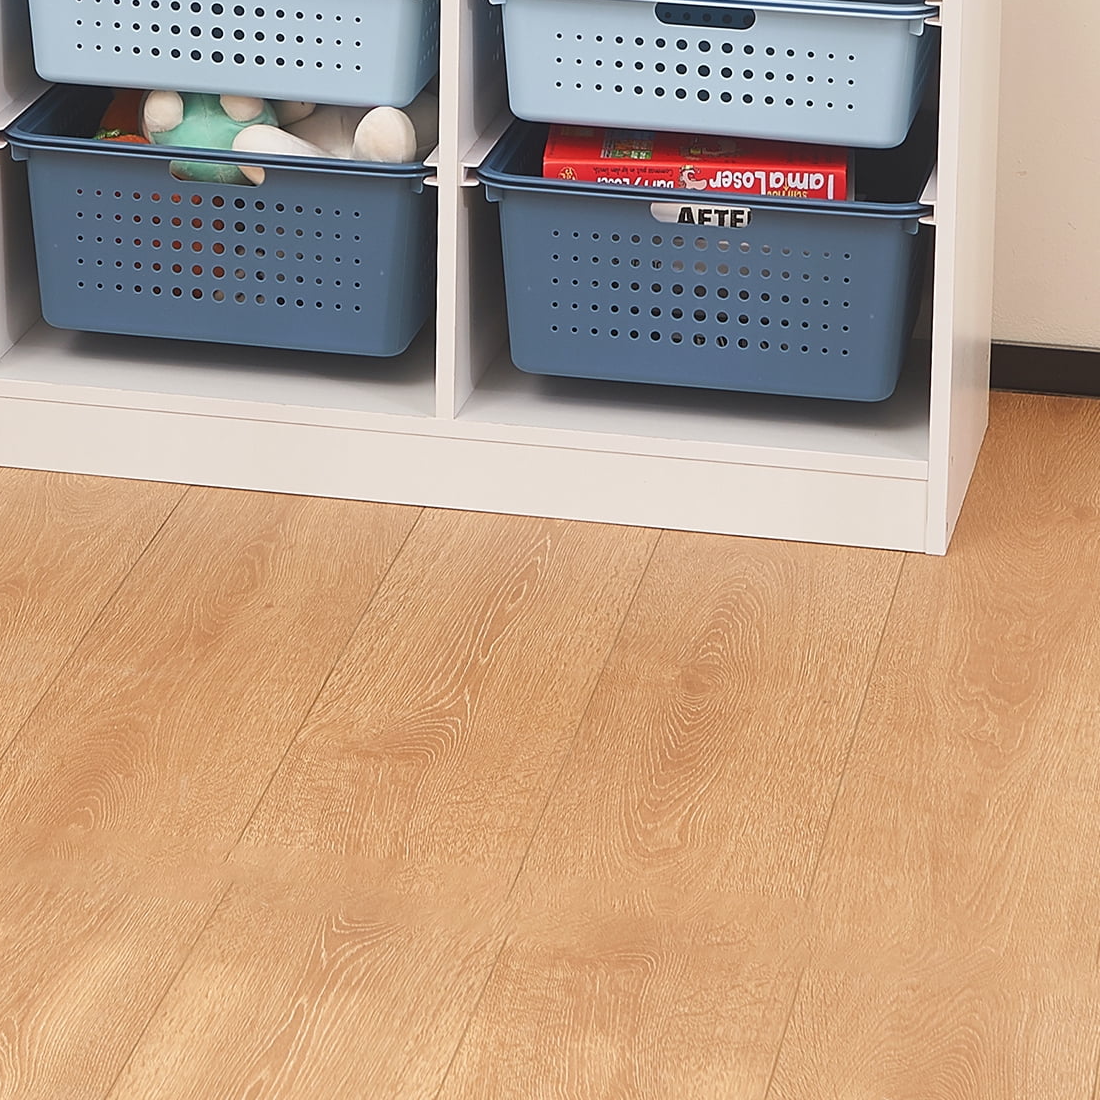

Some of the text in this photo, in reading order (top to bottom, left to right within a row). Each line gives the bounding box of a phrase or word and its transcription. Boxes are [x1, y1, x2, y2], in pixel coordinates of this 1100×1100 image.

[708, 170, 835, 200] I am a Loser
[677, 207, 752, 229] AFTE
